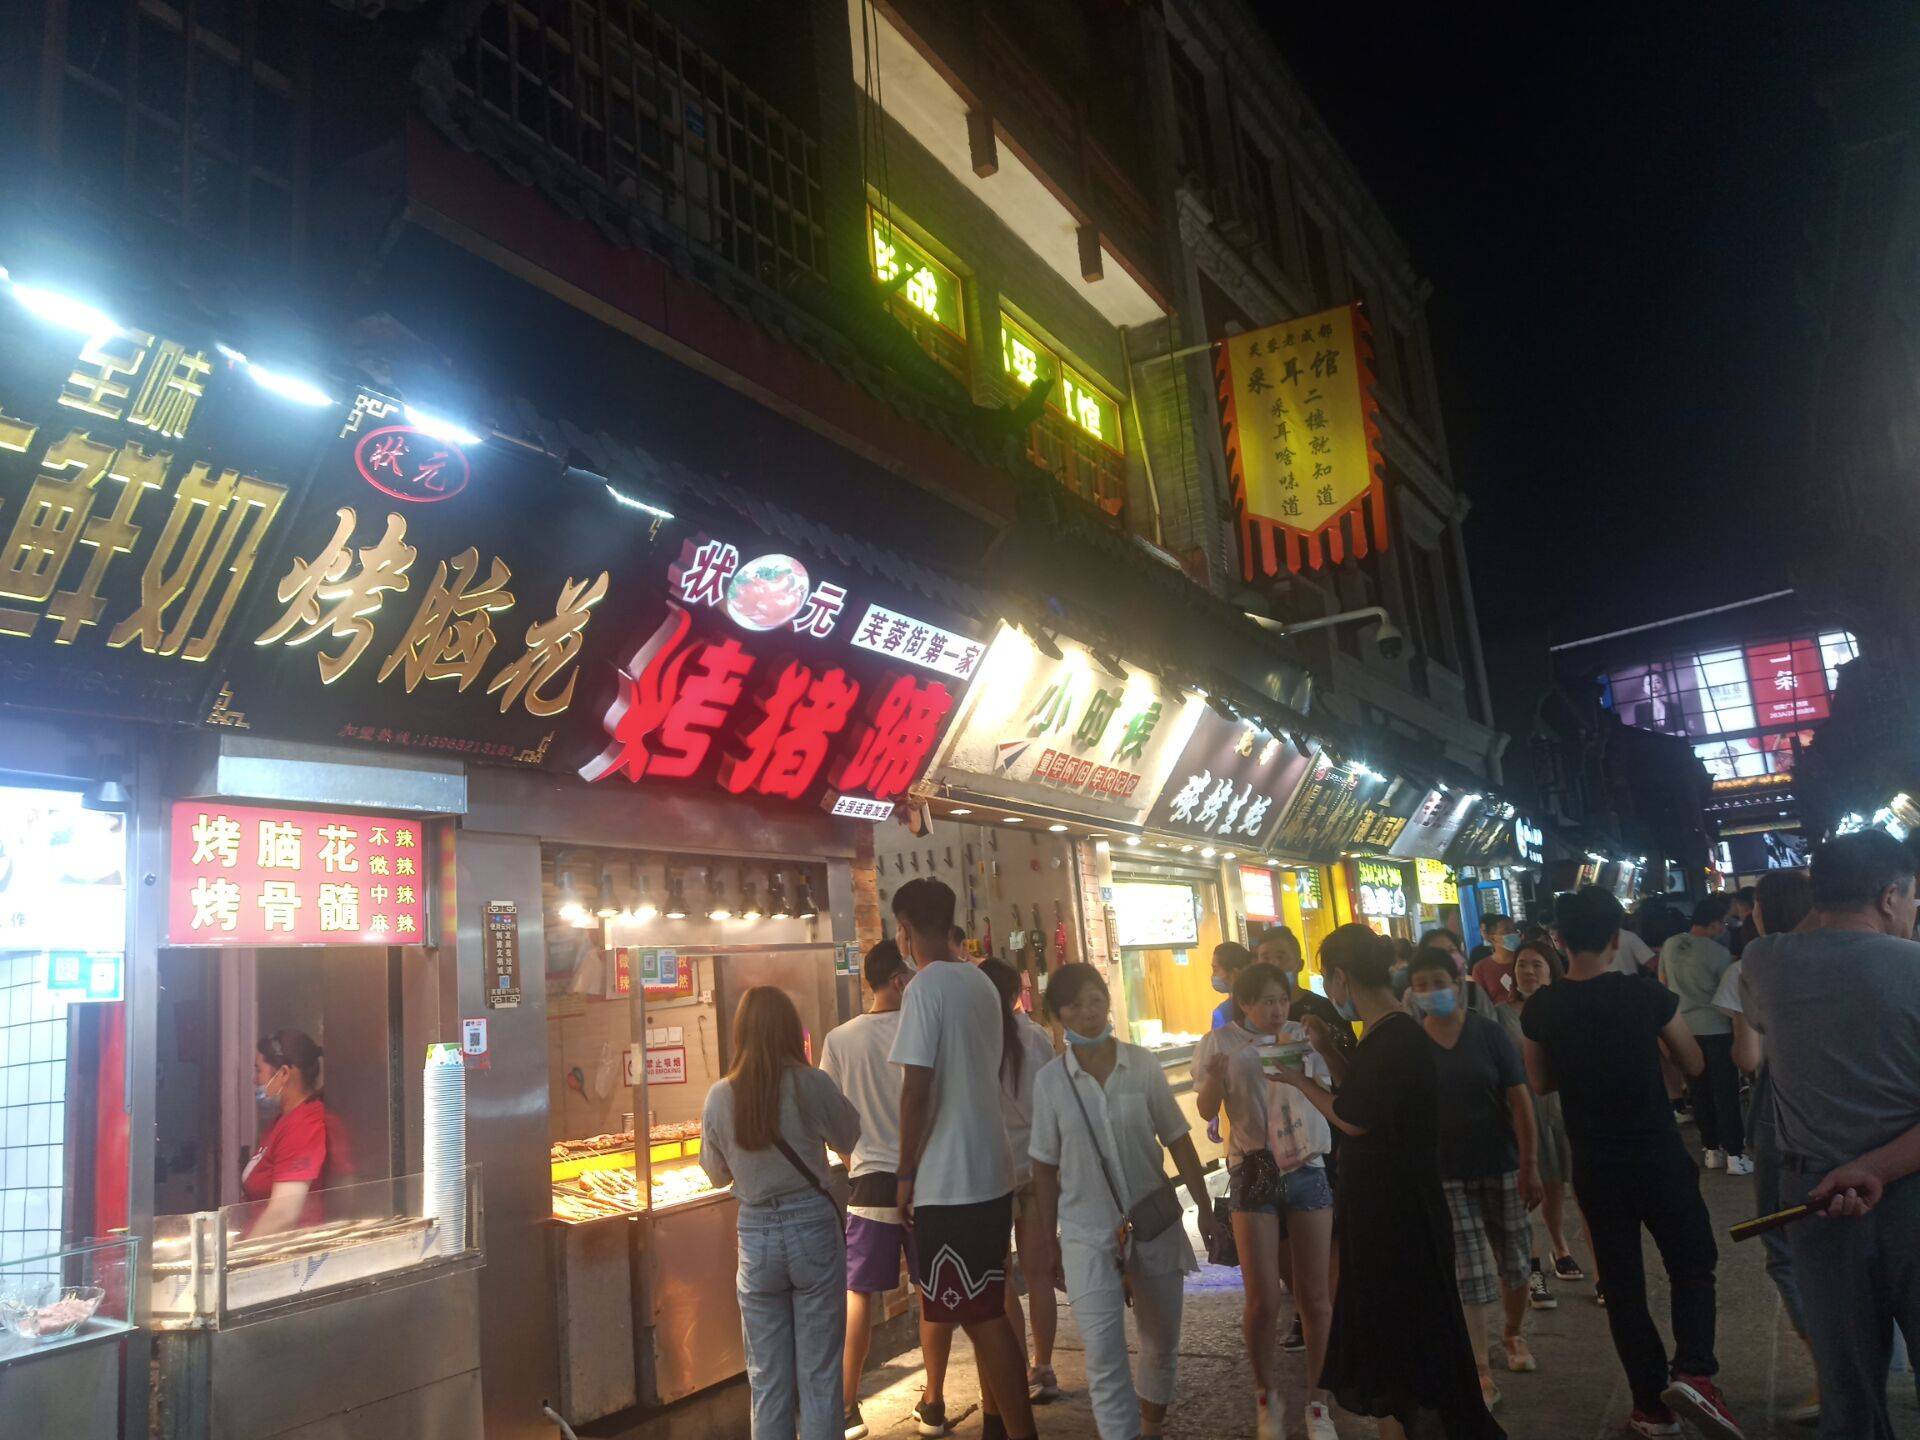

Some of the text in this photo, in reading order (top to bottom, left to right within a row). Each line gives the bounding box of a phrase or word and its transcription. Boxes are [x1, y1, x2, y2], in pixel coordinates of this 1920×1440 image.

[1247, 348, 1340, 395] 采耳馆
[369, 435, 449, 491] 状元
[1270, 397, 1304, 518] 采耳啥味道
[1303, 388, 1339, 507] 二楼就知道
[0, 420, 290, 662] 鲜奶
[254, 506, 610, 717] 烤脑花
[680, 538, 848, 638] 状元
[858, 611, 981, 675] 芙蓉街第一家
[579, 600, 954, 801] 烤猪蹄
[1028, 671, 1163, 763] 小时候
[190, 813, 360, 873] 烤脑花
[368, 825, 416, 848] 不辣
[368, 854, 417, 877] 微辣
[189, 875, 361, 932] 烤骨髓
[368, 912, 417, 933] 麻辣
[369, 882, 417, 906] 中辣
